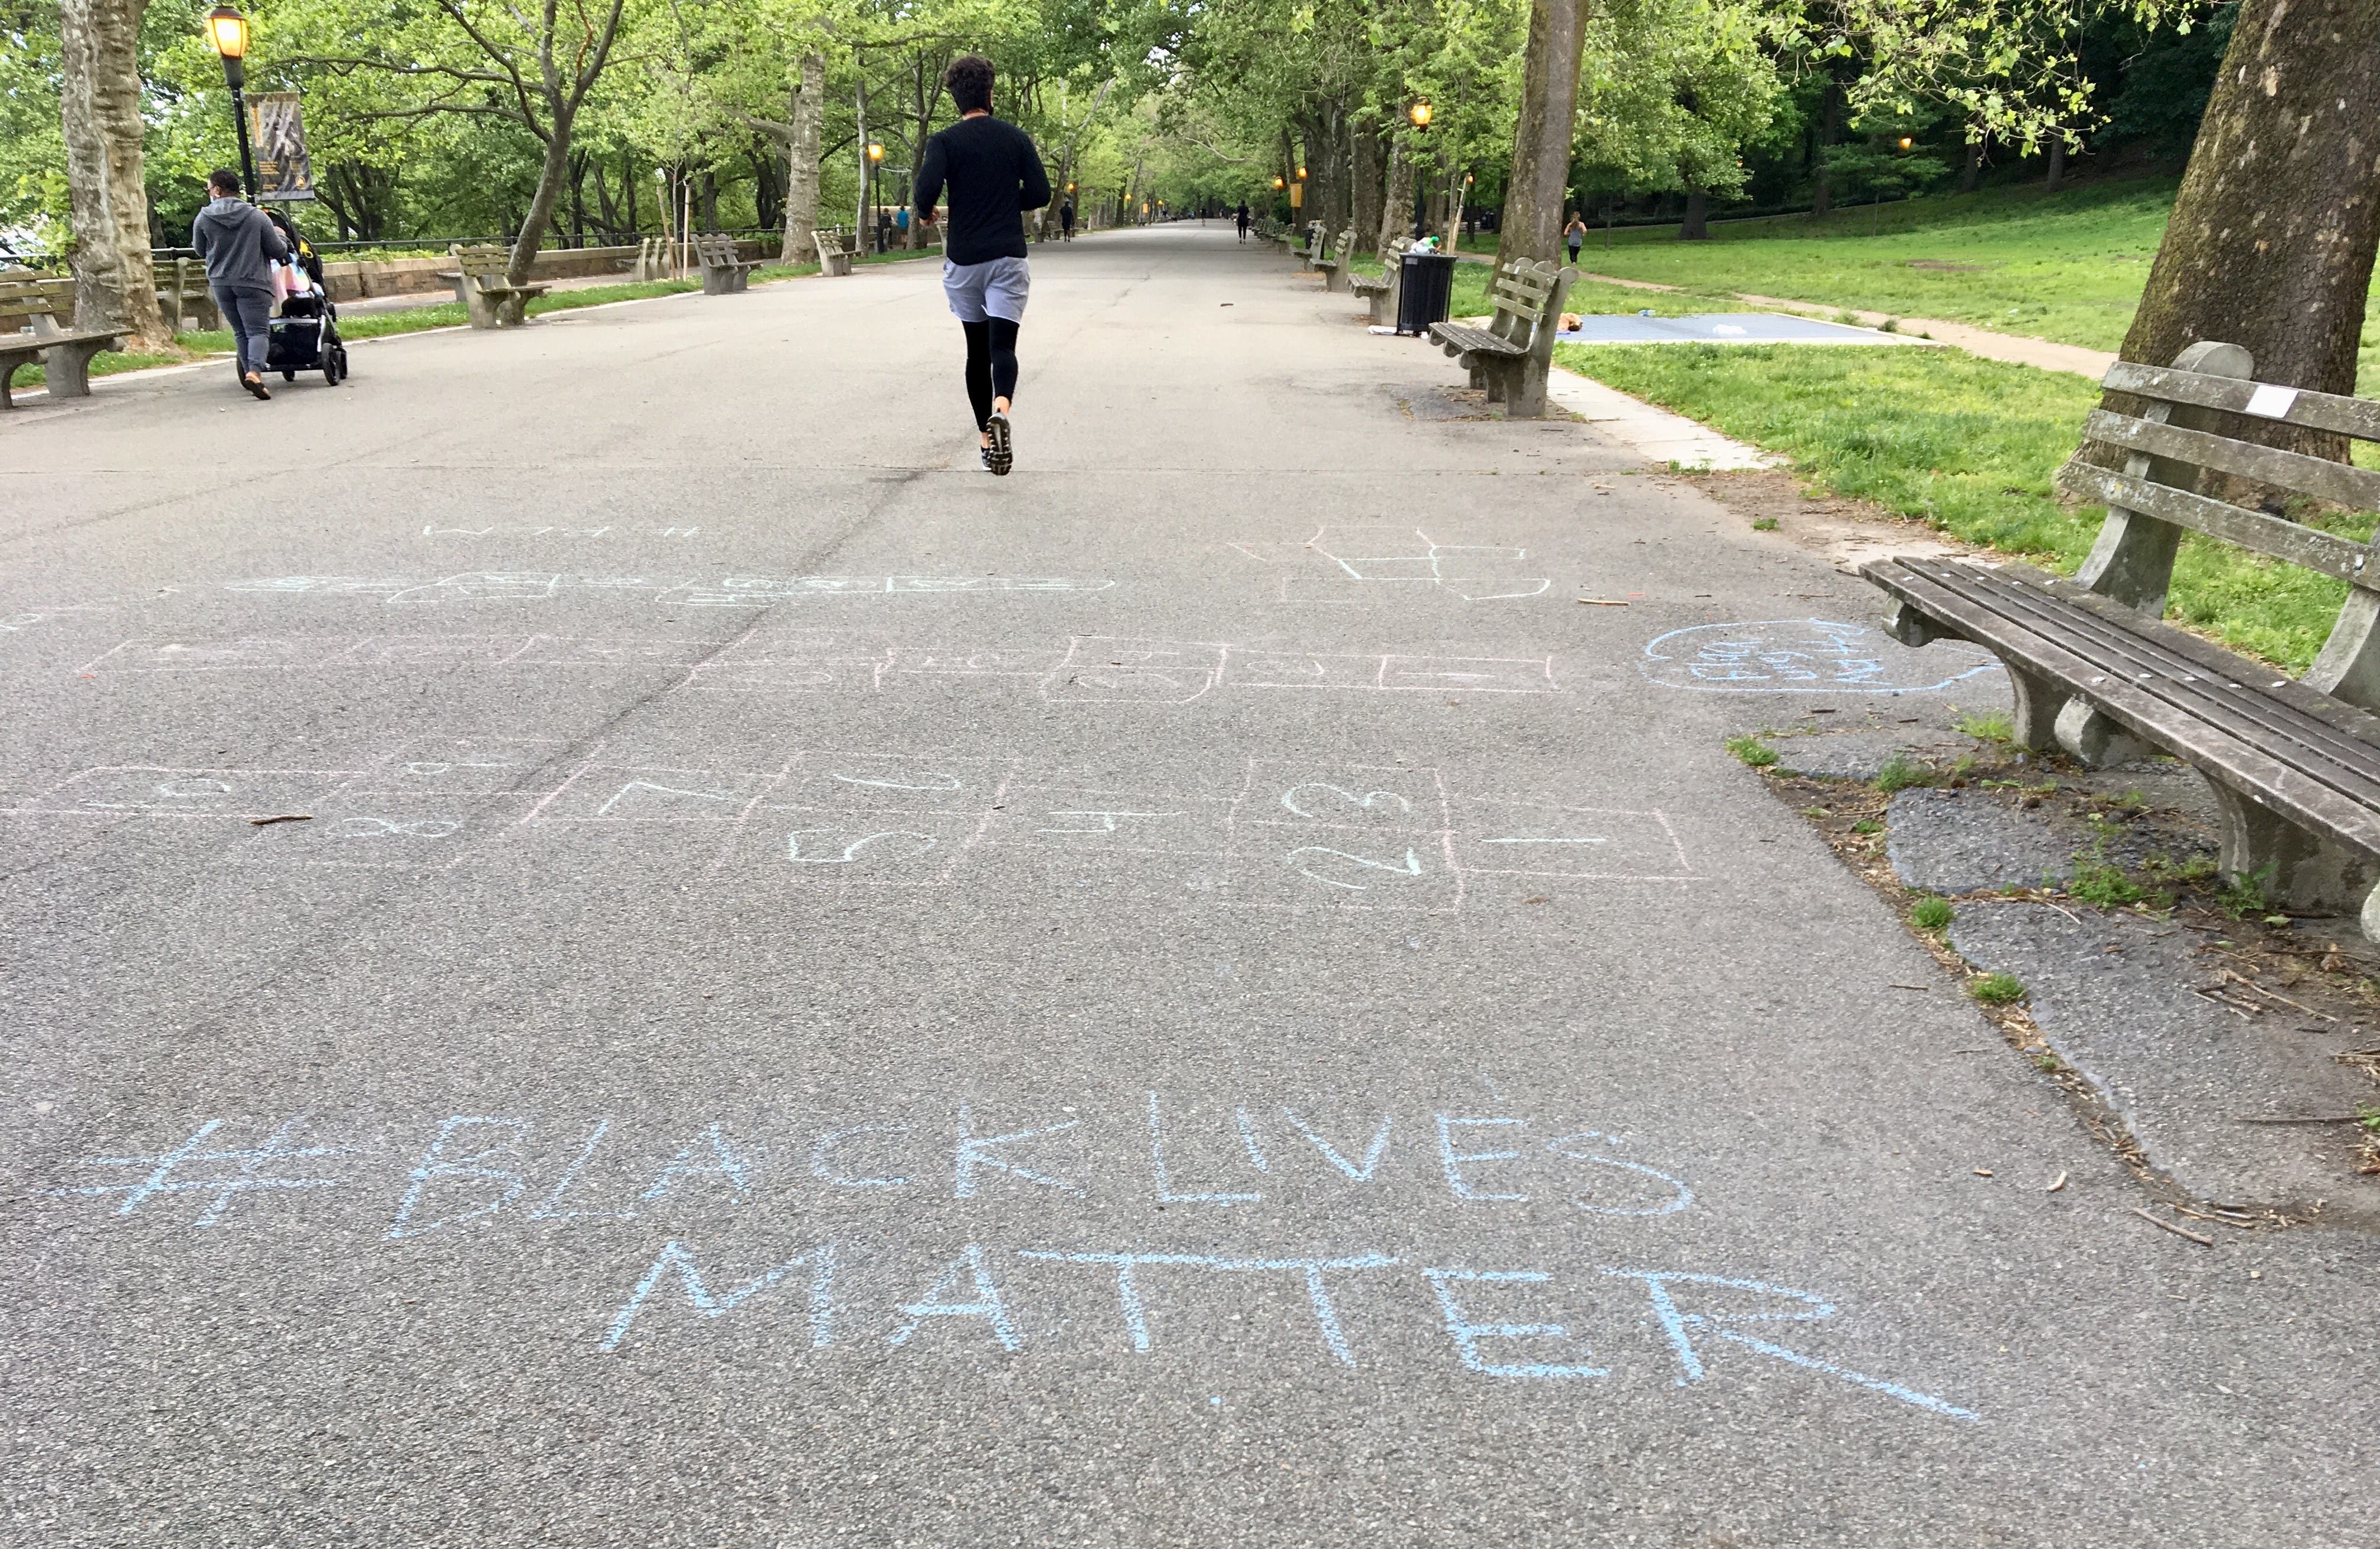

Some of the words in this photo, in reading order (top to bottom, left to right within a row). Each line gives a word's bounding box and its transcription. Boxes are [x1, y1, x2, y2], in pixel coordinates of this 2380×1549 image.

[35, 1102, 1085, 1240] #BLACK
[1148, 1092, 1694, 1217] LIVES
[599, 1238, 1981, 1421] MATTER
